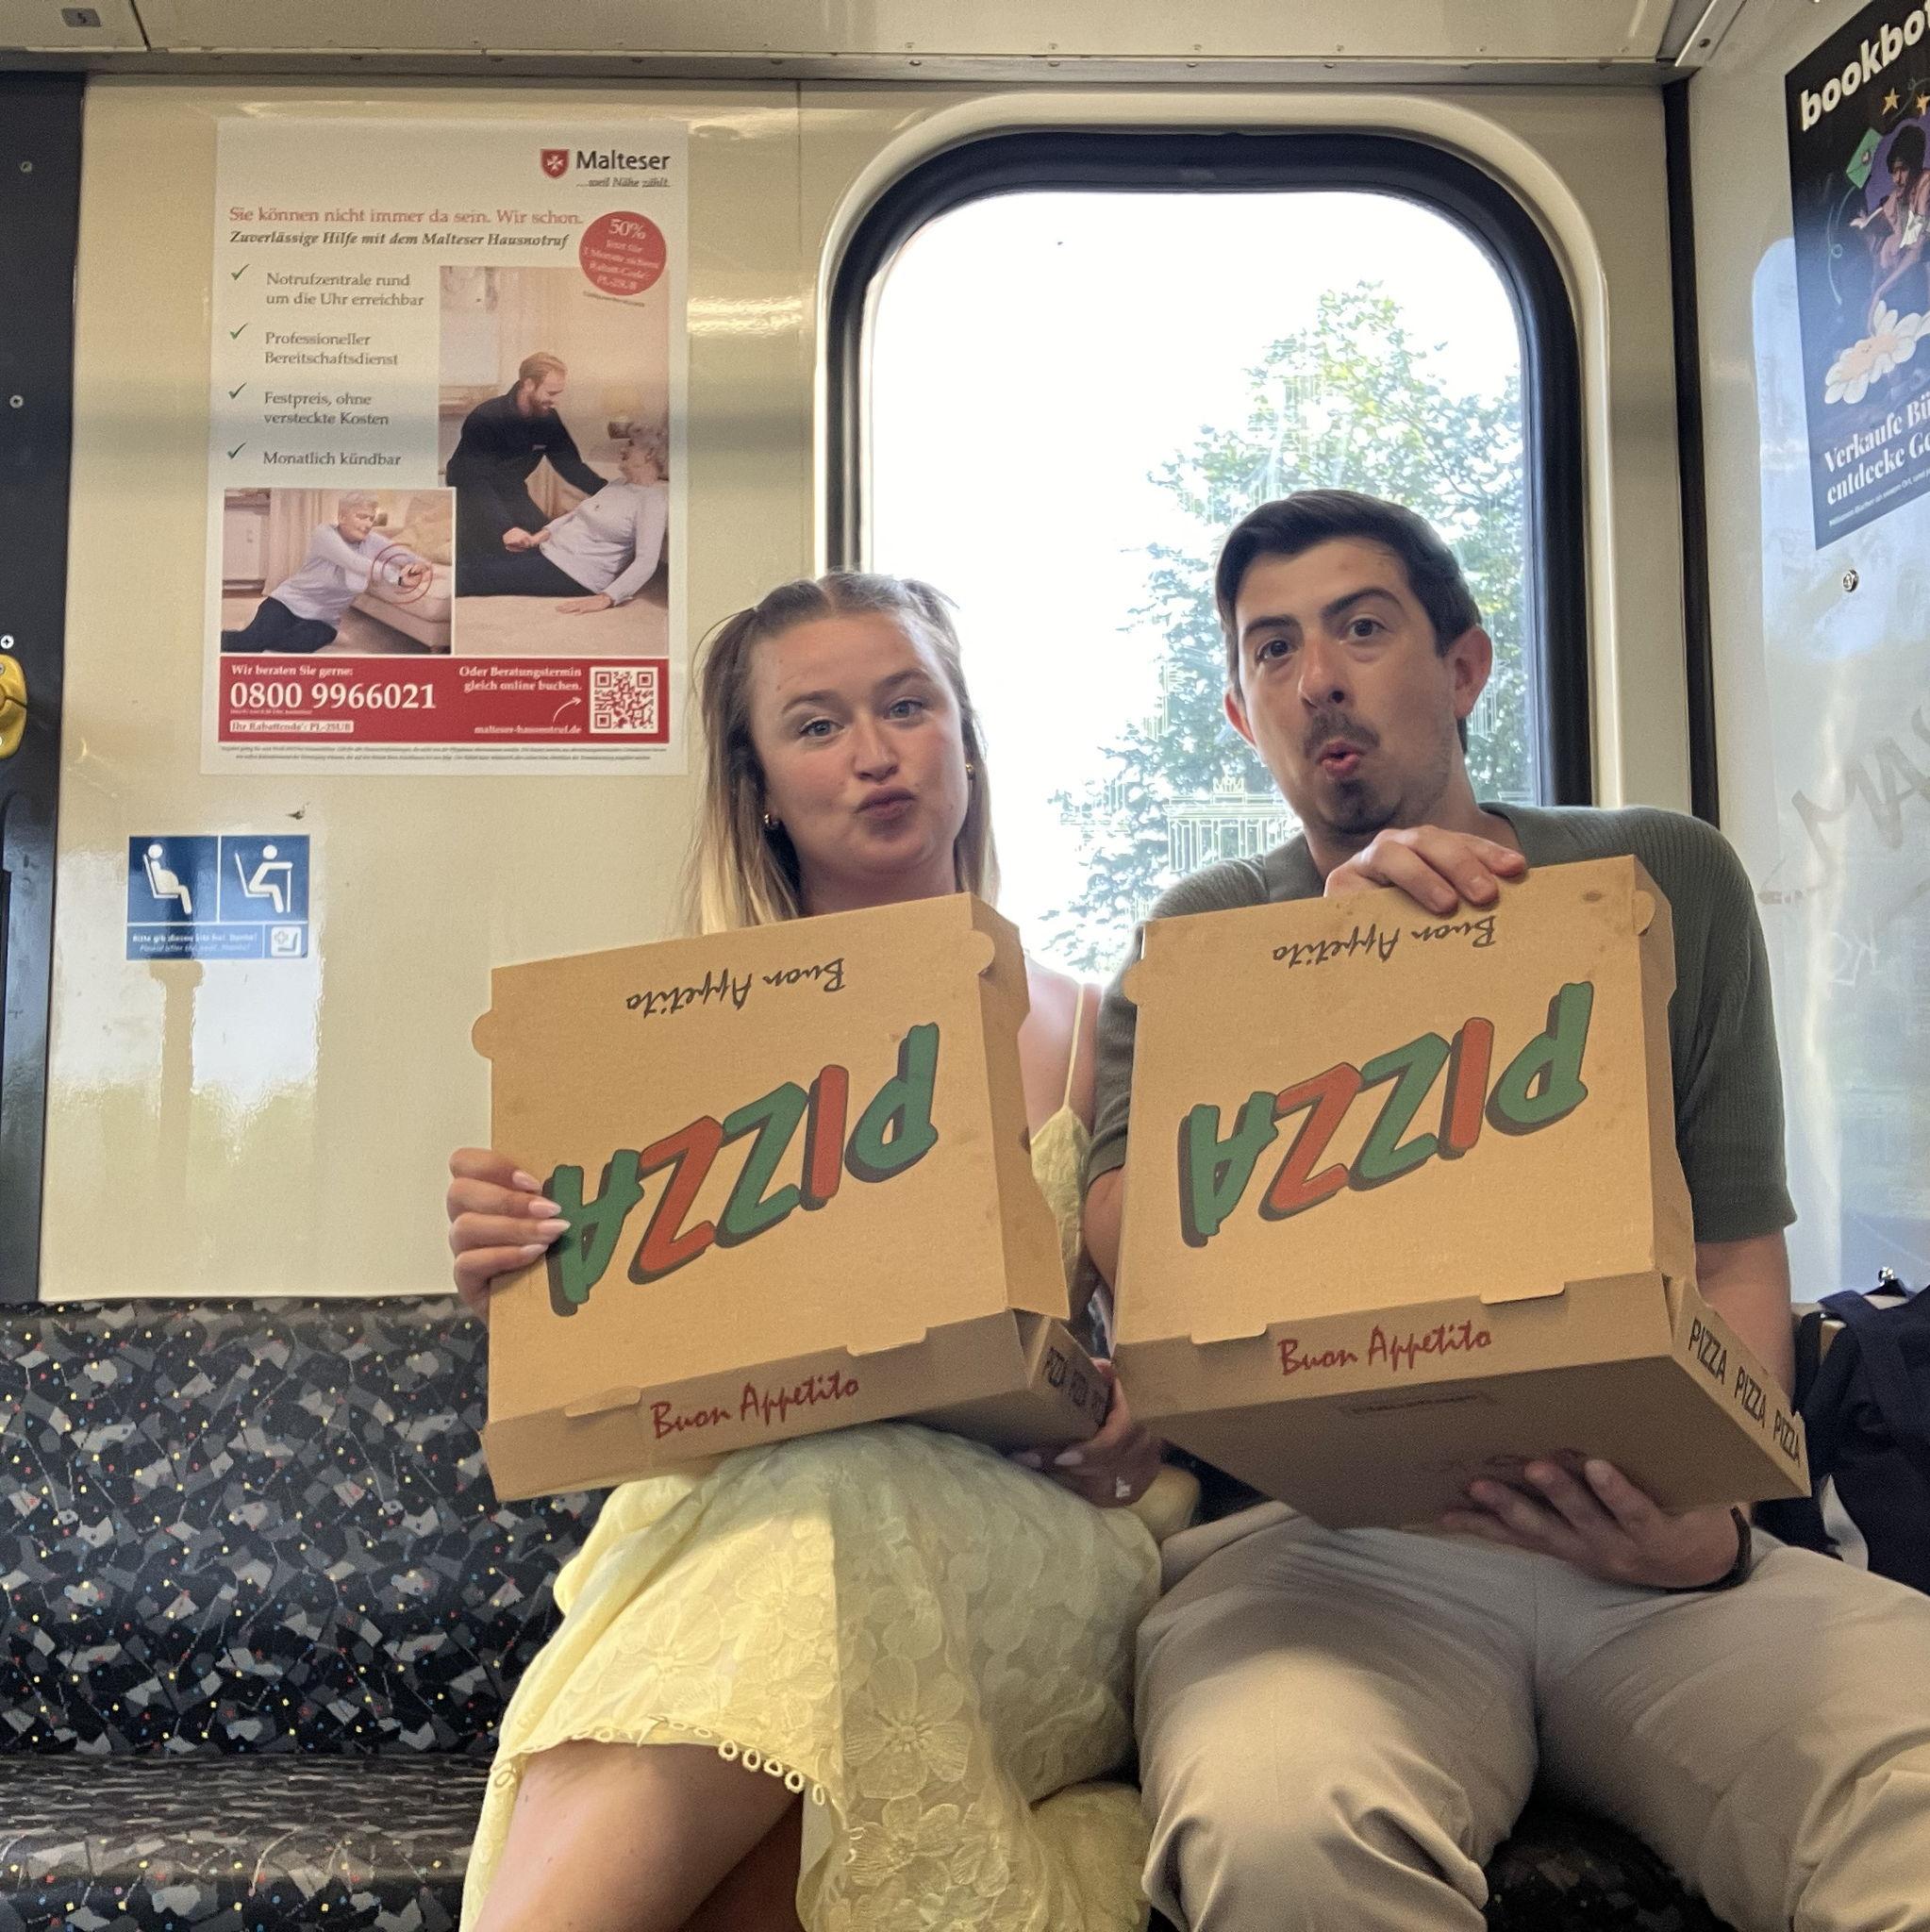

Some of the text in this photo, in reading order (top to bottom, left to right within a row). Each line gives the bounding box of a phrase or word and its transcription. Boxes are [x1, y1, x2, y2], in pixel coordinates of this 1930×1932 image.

[576, 149, 671, 171] Malteser
[612, 176, 640, 188] Nähe
[229, 205, 584, 225] Sie können nicht immer da sein. Wir schon.
[607, 218, 647, 241] 50%
[229, 230, 570, 250] Zuverlässige Hilfe mit dem Malteser Hausnotruf
[266, 272, 411, 287] Notrufzentrale rund
[266, 291, 424, 307] um die Uhr erreichbar
[265, 331, 372, 346] Professioneller
[265, 351, 398, 366] Bereitschaftsdienst
[264, 391, 373, 408] Festpreis, ohne
[263, 411, 390, 425] versteckte Kosten
[1824, 411, 1903, 473] Verkaufe
[263, 451, 402, 466] Monatlich kündbar
[1826, 447, 1905, 507] entdecke
[231, 664, 354, 679] Wir beraten Sie gerne:
[458, 666, 582, 680] Oder Beratungstermin
[229, 681, 437, 709] 0800 9966021
[463, 680, 582, 693] gleich online buchen.
[231, 721, 247, 731] Ihr
[1273, 914, 1497, 970] Buon Appetito
[625, 957, 847, 1020] Buon Appetito
[1178, 981, 1594, 1248] PIZZA
[542, 1022, 940, 1317] PIZZA
[1277, 1318, 1493, 1376] Buon Appetito
[1688, 1315, 1802, 1470] PIZZA PIZZA PIZZA
[649, 1370, 860, 1440] Buon Appetito
